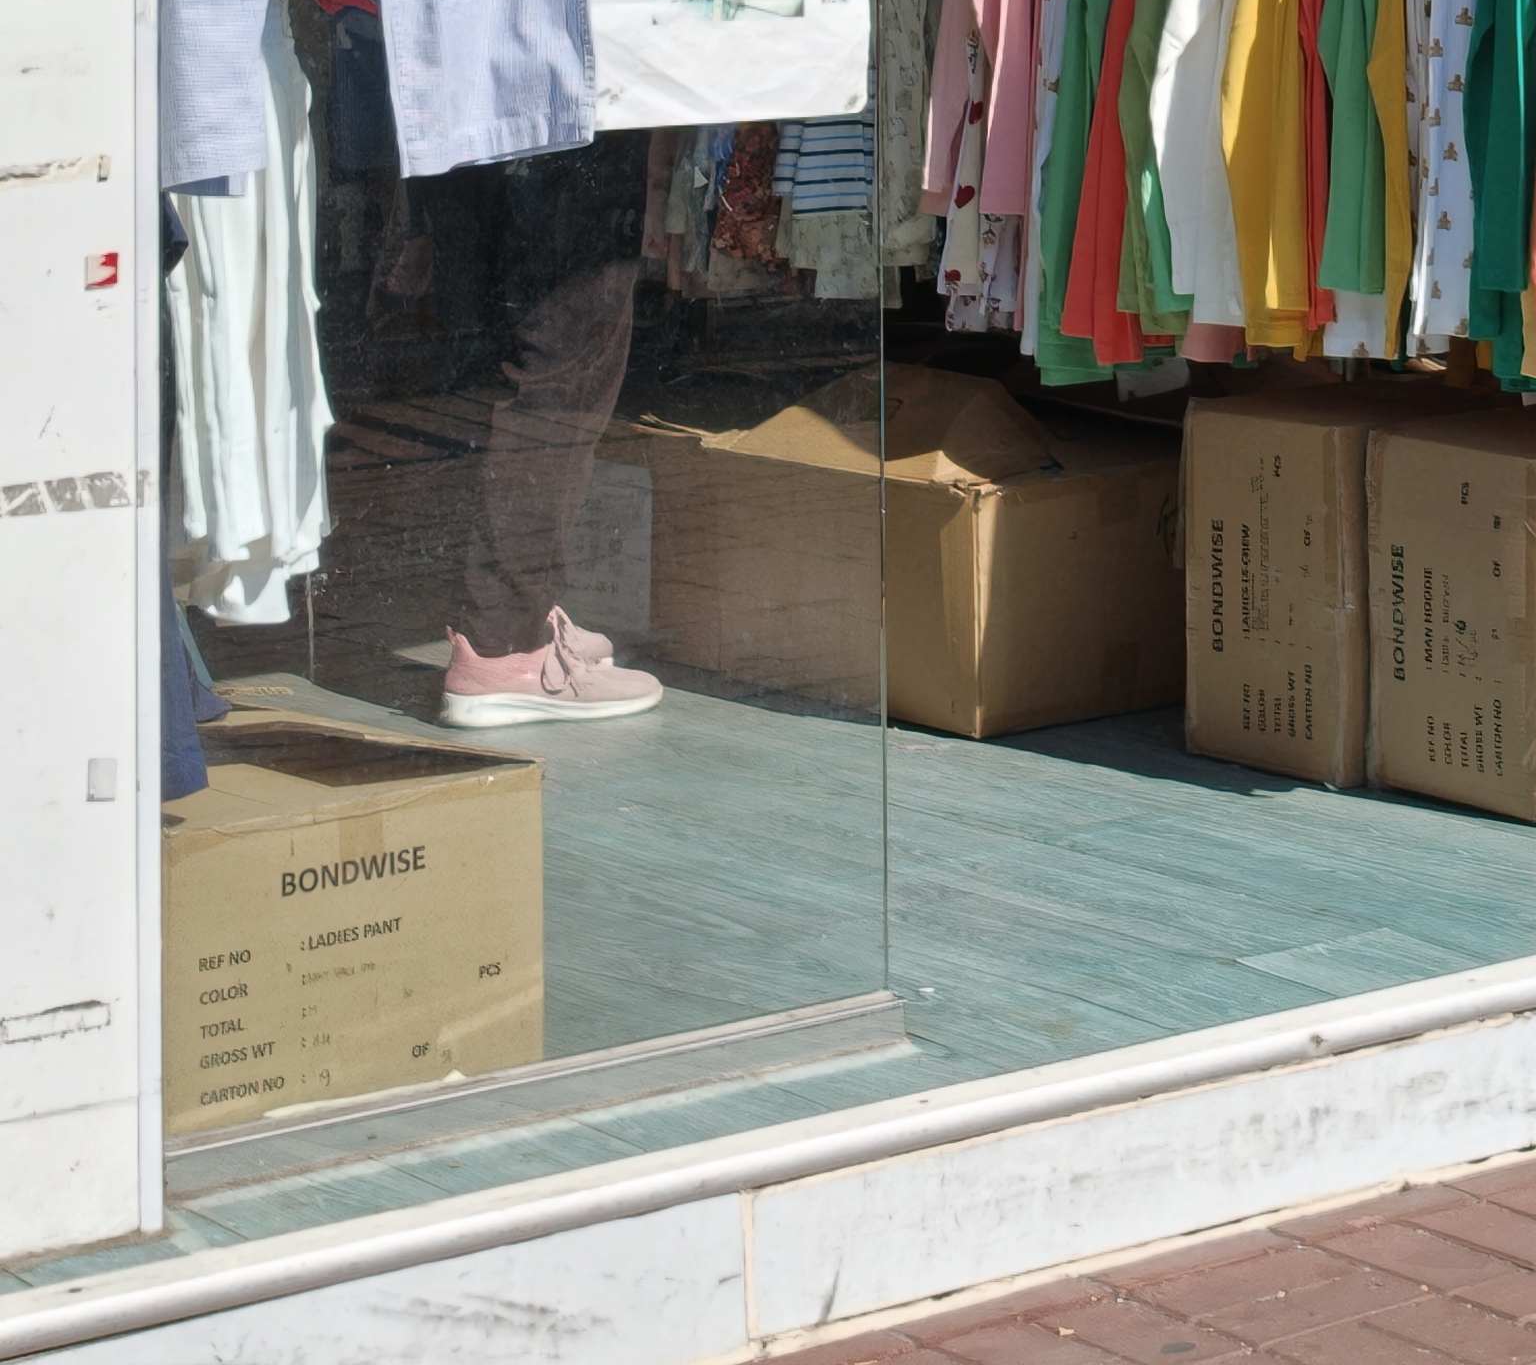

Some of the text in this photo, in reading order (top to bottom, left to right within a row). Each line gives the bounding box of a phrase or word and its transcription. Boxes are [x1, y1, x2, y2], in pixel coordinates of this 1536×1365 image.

[1211, 519, 1225, 654] BONDWISE
[1391, 544, 1406, 682] BONDWISE
[281, 844, 427, 898] BONDWISE
[198, 954, 225, 973] REF
[228, 948, 252, 967] NO
[306, 925, 360, 952] LADIES
[363, 916, 403, 940] PANT
[199, 982, 249, 1006] COLOR
[199, 1017, 246, 1040] TOTAL
[199, 1041, 276, 1070] GROSS WT
[199, 1079, 260, 1107] CARTON
[262, 1075, 286, 1093] NO
[411, 1042, 431, 1059] OF
